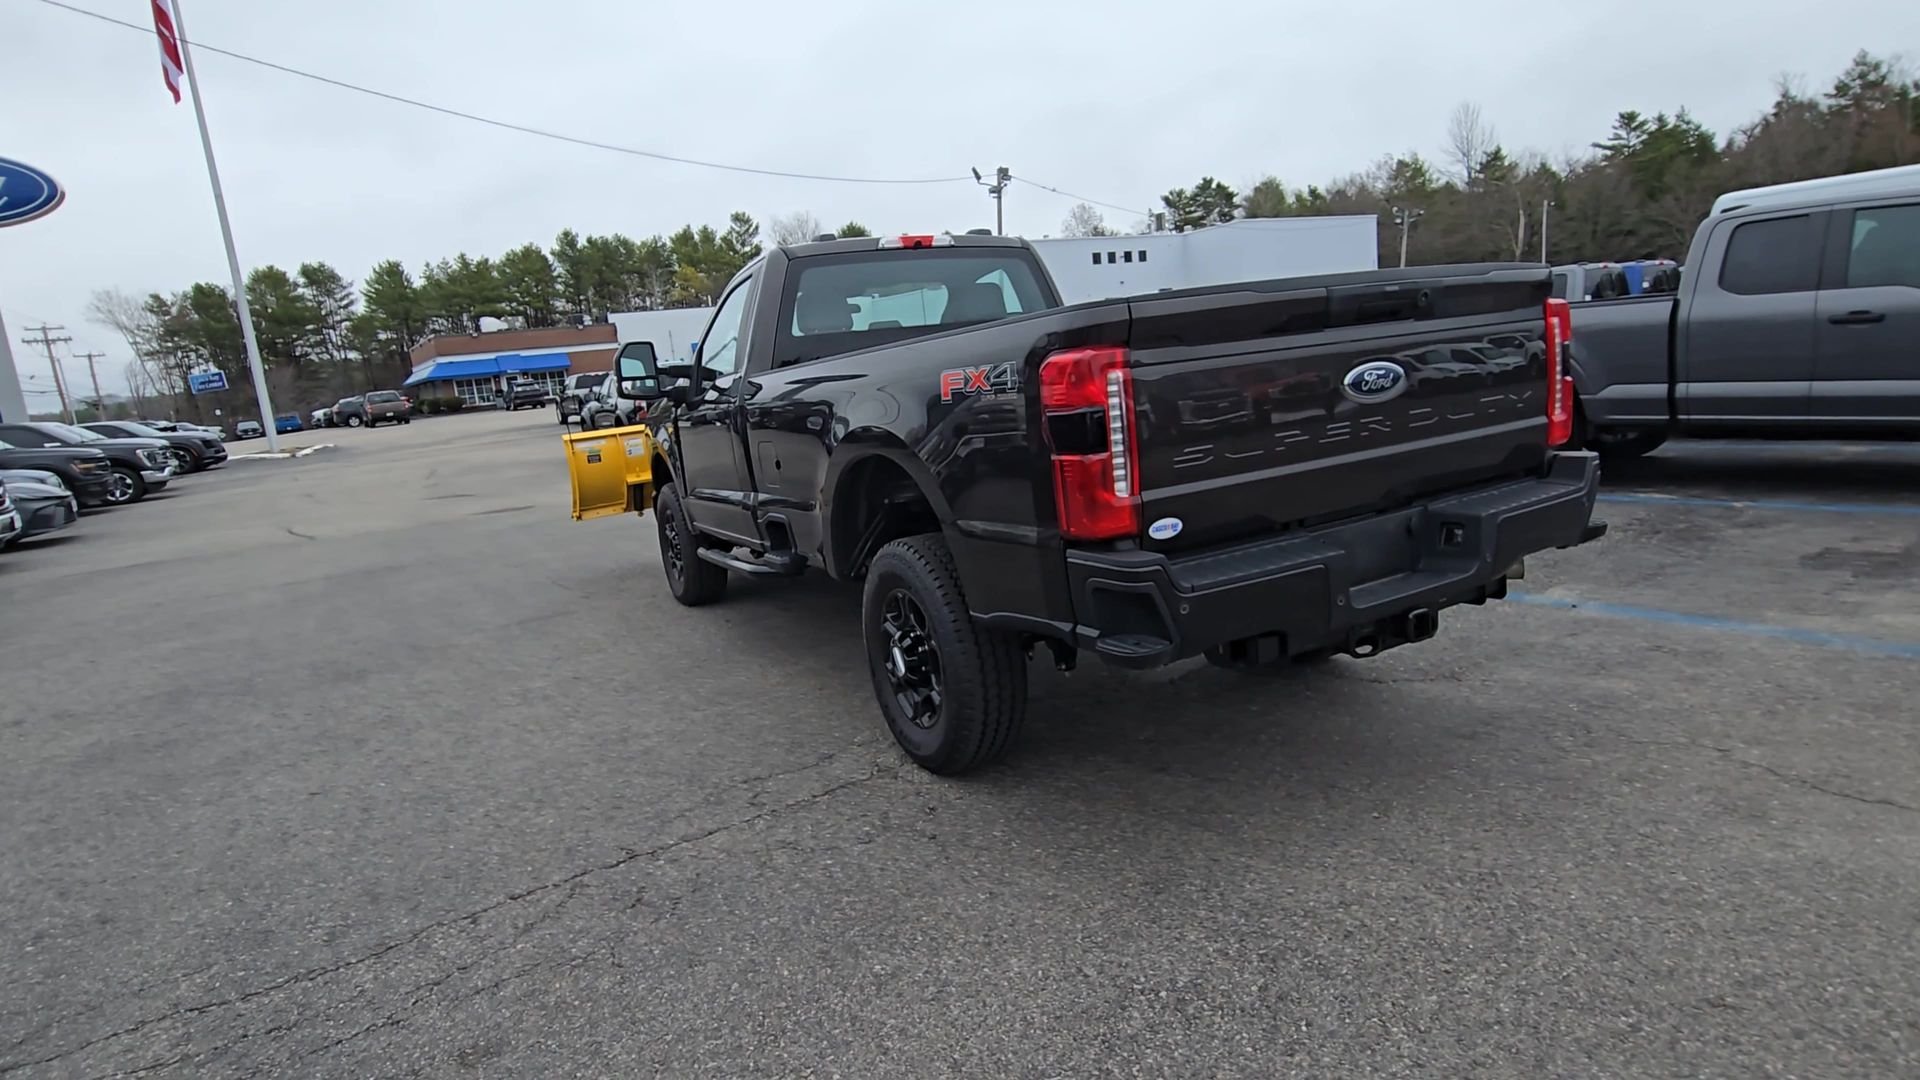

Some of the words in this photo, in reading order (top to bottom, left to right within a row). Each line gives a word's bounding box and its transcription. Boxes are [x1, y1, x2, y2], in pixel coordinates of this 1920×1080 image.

[941, 361, 1018, 404] FX4
[1361, 369, 1394, 391] Ford
[1173, 416, 1392, 469] SUPER
[1408, 390, 1532, 428] DUTY
